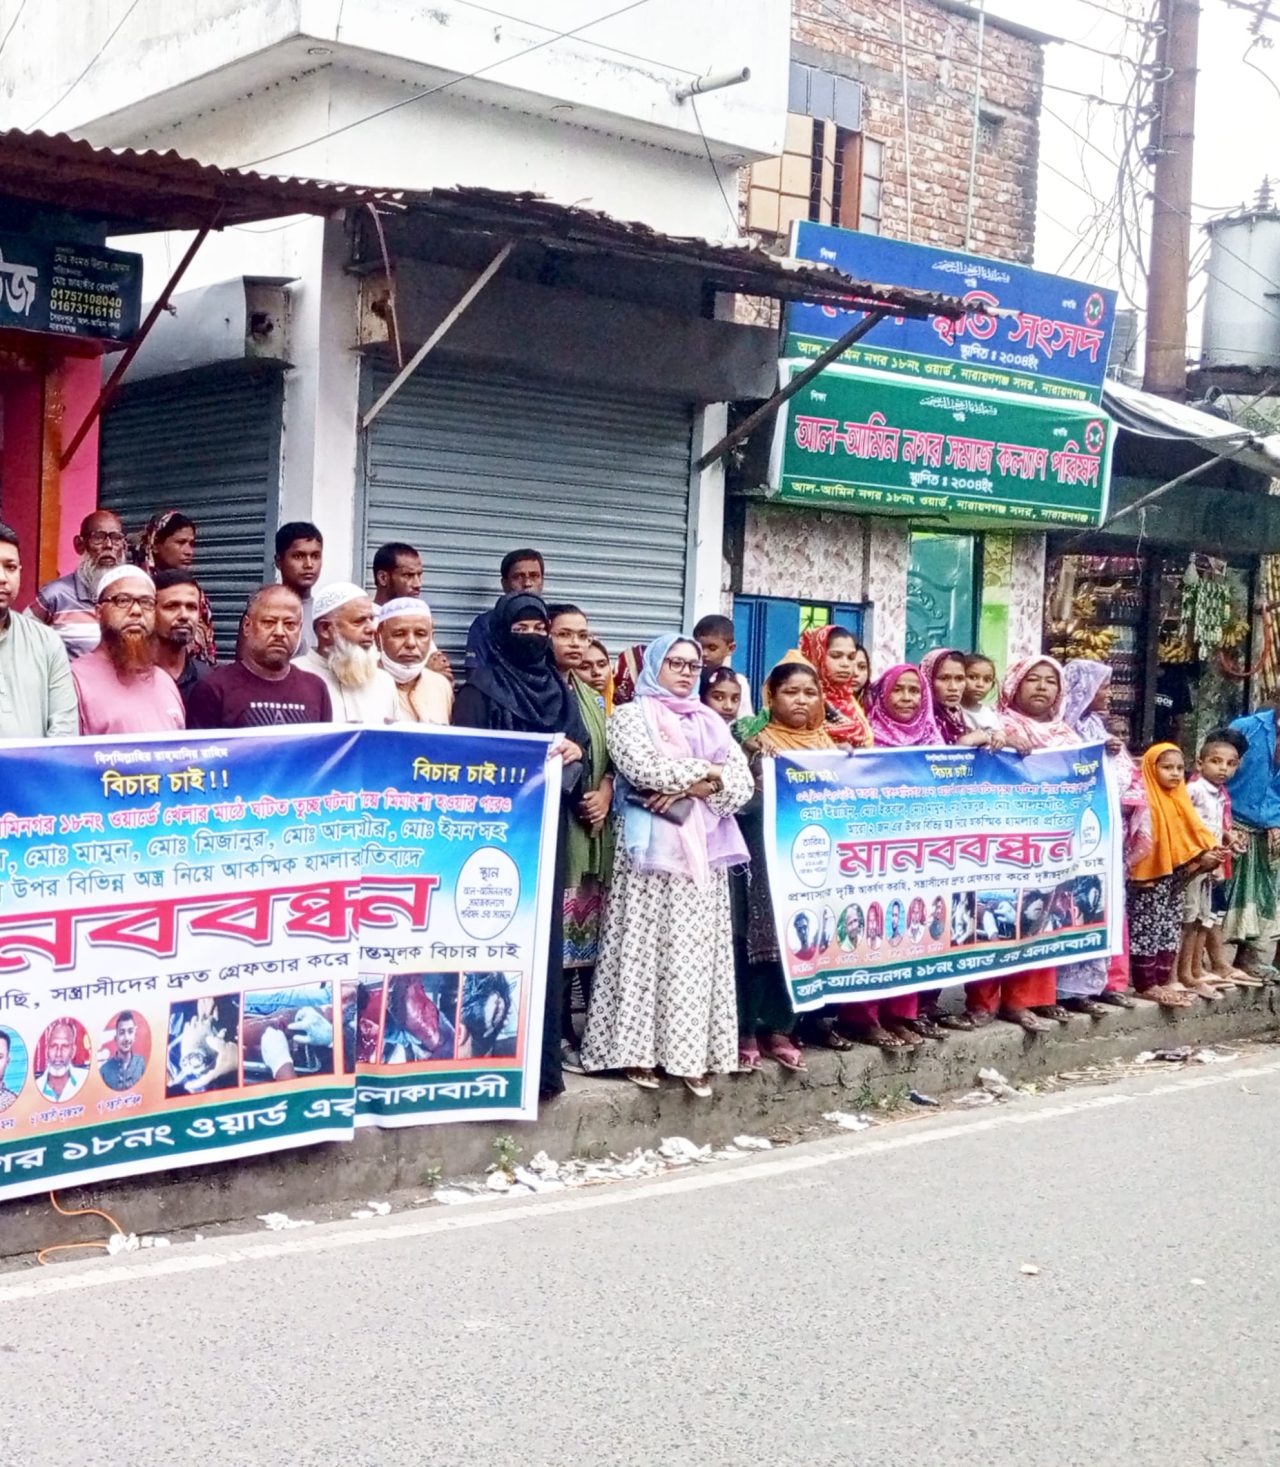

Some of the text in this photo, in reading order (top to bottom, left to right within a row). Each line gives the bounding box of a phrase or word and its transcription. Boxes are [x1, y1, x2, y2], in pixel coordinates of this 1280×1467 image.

[50, 288, 122, 308] 01757108040
[50, 299, 121, 319] 01673716116
[1008, 311, 1105, 363] সংসদ
[795, 411, 1100, 488] আল-আমিন নগর সমাজ কল্যাণ পরিষদ
[791, 481, 855, 499] আল-আমিন
[858, 488, 883, 501] নগর
[101, 768, 160, 798] বিচার
[412, 757, 461, 783] বিচার
[59, 815, 105, 836] ১৮নং
[163, 803, 210, 827] খেলার
[213, 796, 246, 821] মাঠে
[250, 796, 289, 818] ঘটিত
[293, 796, 321, 820] তুচ্ছ
[323, 791, 356, 812] ঘটনা
[478, 794, 513, 814] পরেও
[24, 842, 69, 869] মোঃ
[146, 833, 189, 858] মোঃ
[282, 823, 317, 847] মোঃ
[401, 818, 435, 840] মোঃ
[439, 815, 478, 842] ইমন
[478, 821, 509, 843] সহ
[12, 870, 60, 899] উপর
[67, 868, 125, 897] বিভিন্ন
[133, 867, 166, 888] অস্ত্র
[173, 862, 215, 886] নিয়ে
[221, 853, 297, 880] আকস্মিক
[304, 849, 361, 873] হামলার
[50, 975, 158, 1003] সন্ত্রাসীদের
[166, 969, 210, 989] দ্রুত
[218, 957, 300, 982] গ্রেফতার
[305, 949, 350, 967] করে
[430, 940, 480, 960] বিচার
[486, 943, 522, 960] চাই
[63, 1125, 175, 1161] ১৮নং
[186, 1101, 289, 1137] ওয়ার্ড
[303, 1097, 357, 1118] এর
[357, 1074, 509, 1106] লাকাবাসী
